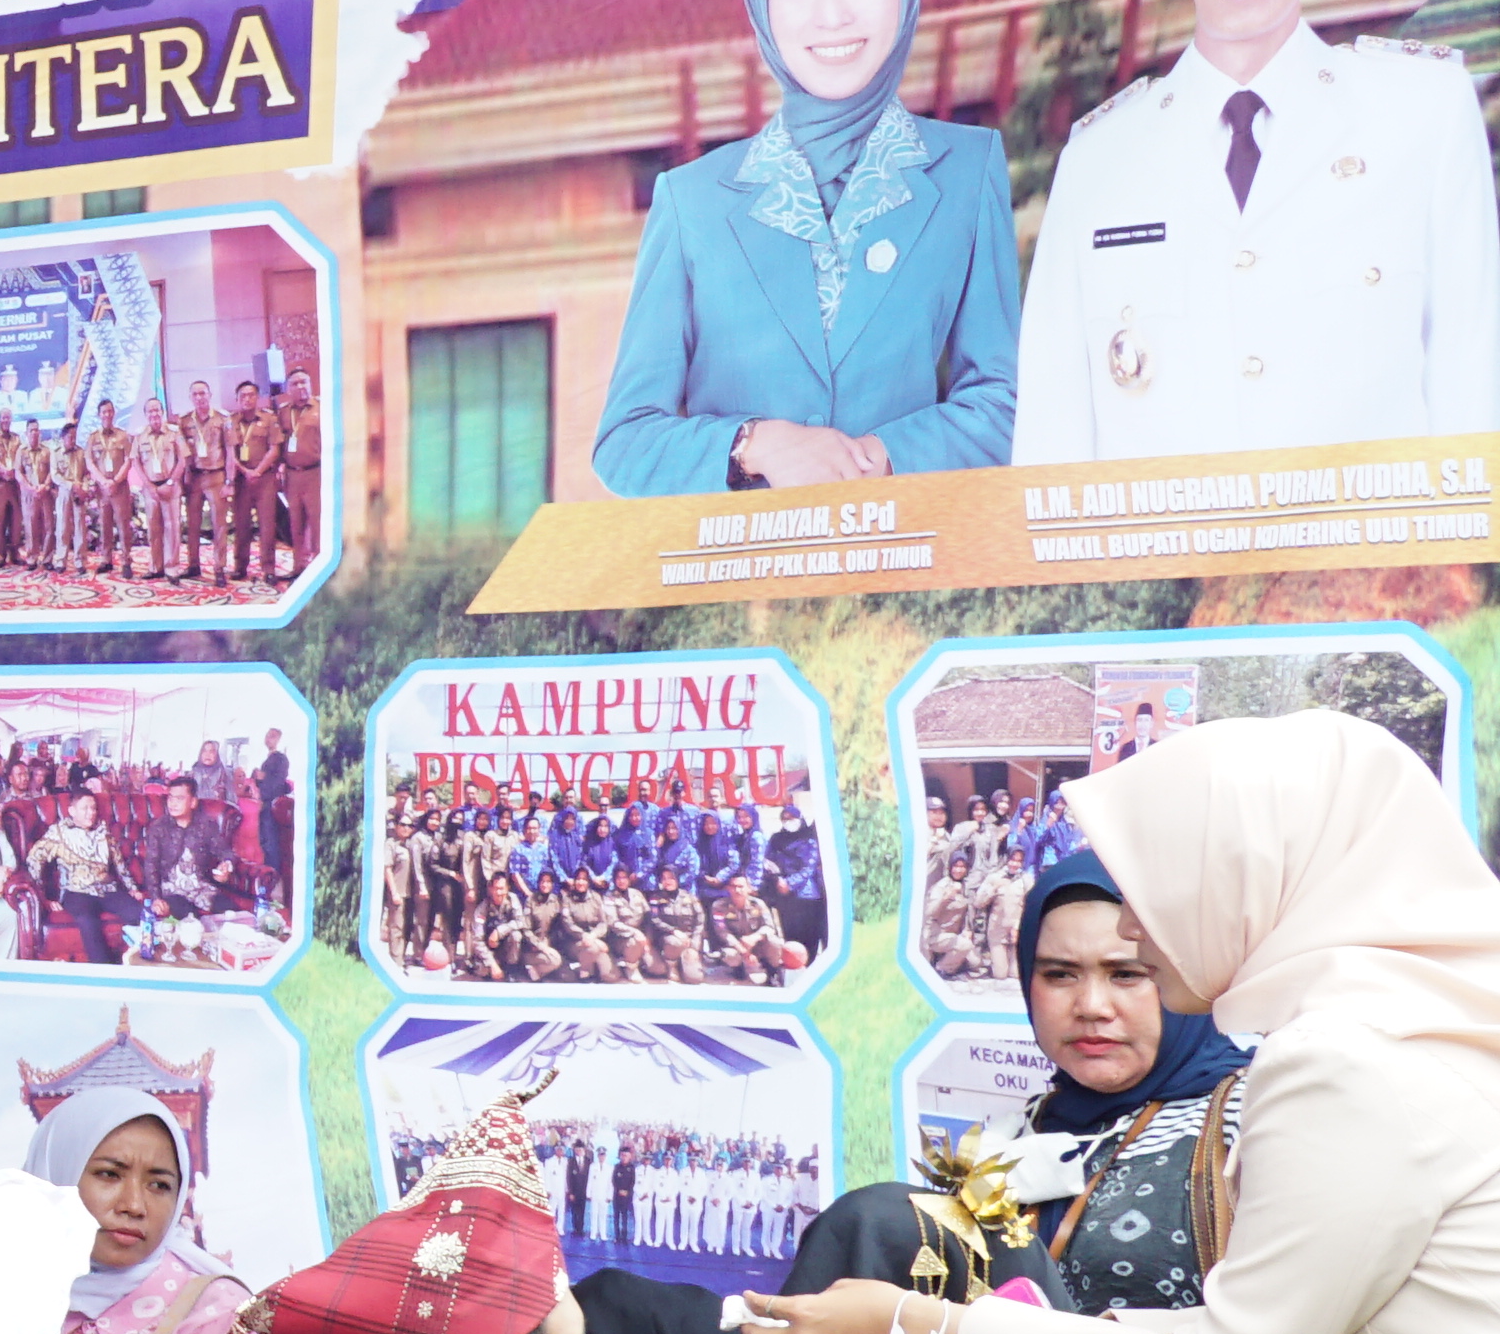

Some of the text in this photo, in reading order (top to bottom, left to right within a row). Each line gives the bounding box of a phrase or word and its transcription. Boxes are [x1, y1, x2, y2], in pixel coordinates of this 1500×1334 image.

[18, 329, 55, 343] PUSAT
[1024, 456, 1492, 521] H.M. ADI NUGRAHA PURNA YUDHA, S.H.
[698, 501, 896, 547] NUR INAYAH, S.Pd
[1032, 512, 1490, 562] WAKIL BUPATI OGAN KOMERING ULU TIMUR
[661, 545, 933, 585] WAKIL KETUA TP PKK KAB. OKU TIMUR
[443, 673, 758, 738] KAMPUNG
[1103, 731, 1115, 752] 3
[969, 1045, 1055, 1073] KECAMATA
[993, 1072, 1029, 1091] OKU
